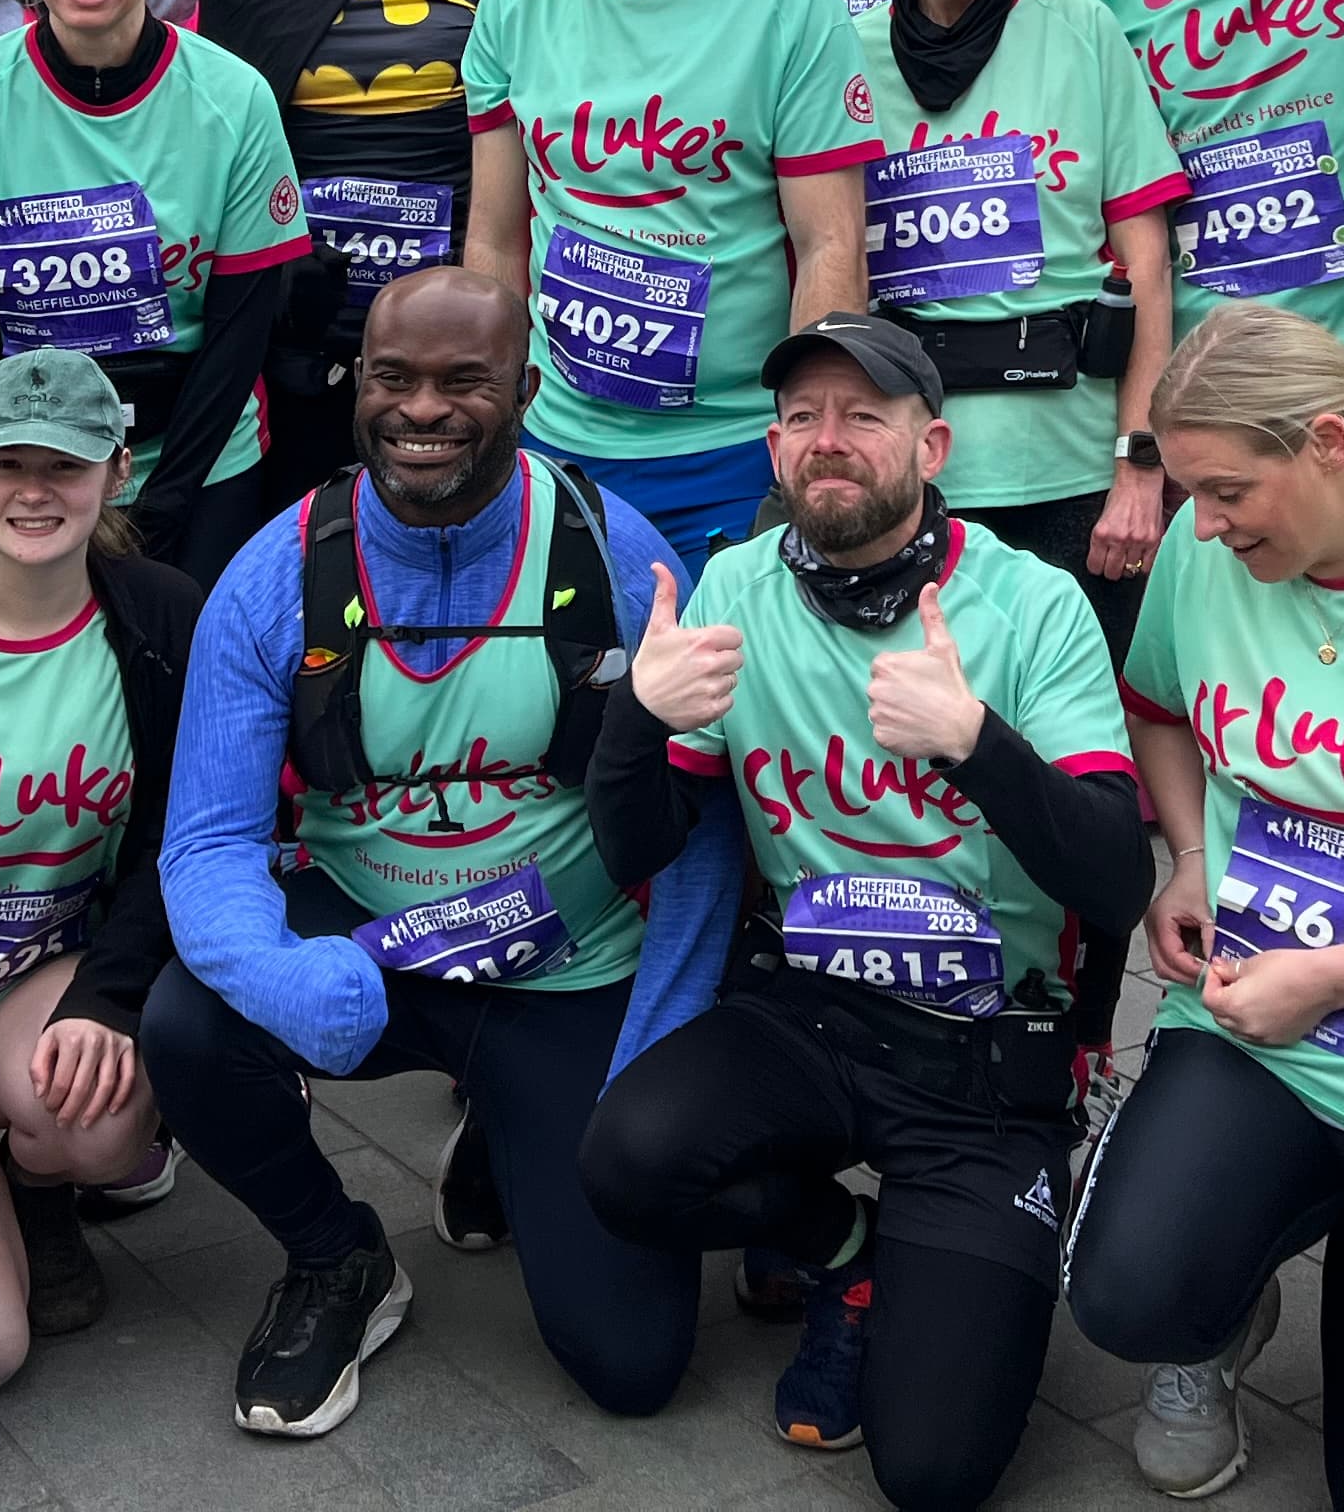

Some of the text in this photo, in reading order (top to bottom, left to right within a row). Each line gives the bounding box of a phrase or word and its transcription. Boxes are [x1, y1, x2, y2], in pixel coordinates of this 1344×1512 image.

[1258, 90, 1336, 121] Hospice
[571, 94, 744, 183] Luke's
[908, 148, 962, 166] SHEFFIELD
[908, 153, 1012, 176] HALF MARATHON
[1200, 141, 1259, 165] SHEFFIELD
[1204, 141, 1311, 176] HALF MARATHON
[1271, 154, 1316, 176] 2023
[972, 166, 1016, 182] 2023
[342, 191, 437, 210] HALF MARATHON
[343, 181, 396, 196] SHEFFIELD
[23, 197, 81, 214] SHEFFIELD
[24, 201, 131, 225] HALF MARATHON
[399, 209, 437, 223] 2023
[1203, 189, 1321, 244] 4982
[91, 213, 135, 233] 2023
[895, 197, 1011, 249] 5068
[588, 246, 642, 270] SHEFFIELD
[11, 247, 132, 296] 3208
[586, 259, 689, 292] HALF MARATHON
[16, 288, 138, 311] SHEFFIELDDIVING
[644, 287, 688, 308] 2023
[912, 287, 926, 297] ALL
[133, 326, 170, 345] 3208
[559, 299, 675, 357] 4027
[586, 347, 631, 371] PETER
[744, 747, 816, 835] St
[355, 847, 539, 886] Sheffield's Hospice
[849, 880, 919, 895] SHEFFIELD
[408, 900, 468, 925] SHEFFIELD
[849, 894, 885, 907] HALF
[413, 892, 524, 938] HALF MARATHON
[486, 904, 533, 934] 2023
[927, 914, 978, 934] 2023
[825, 948, 968, 988] 4815
[1026, 1021, 1055, 1032] ZIKEE
